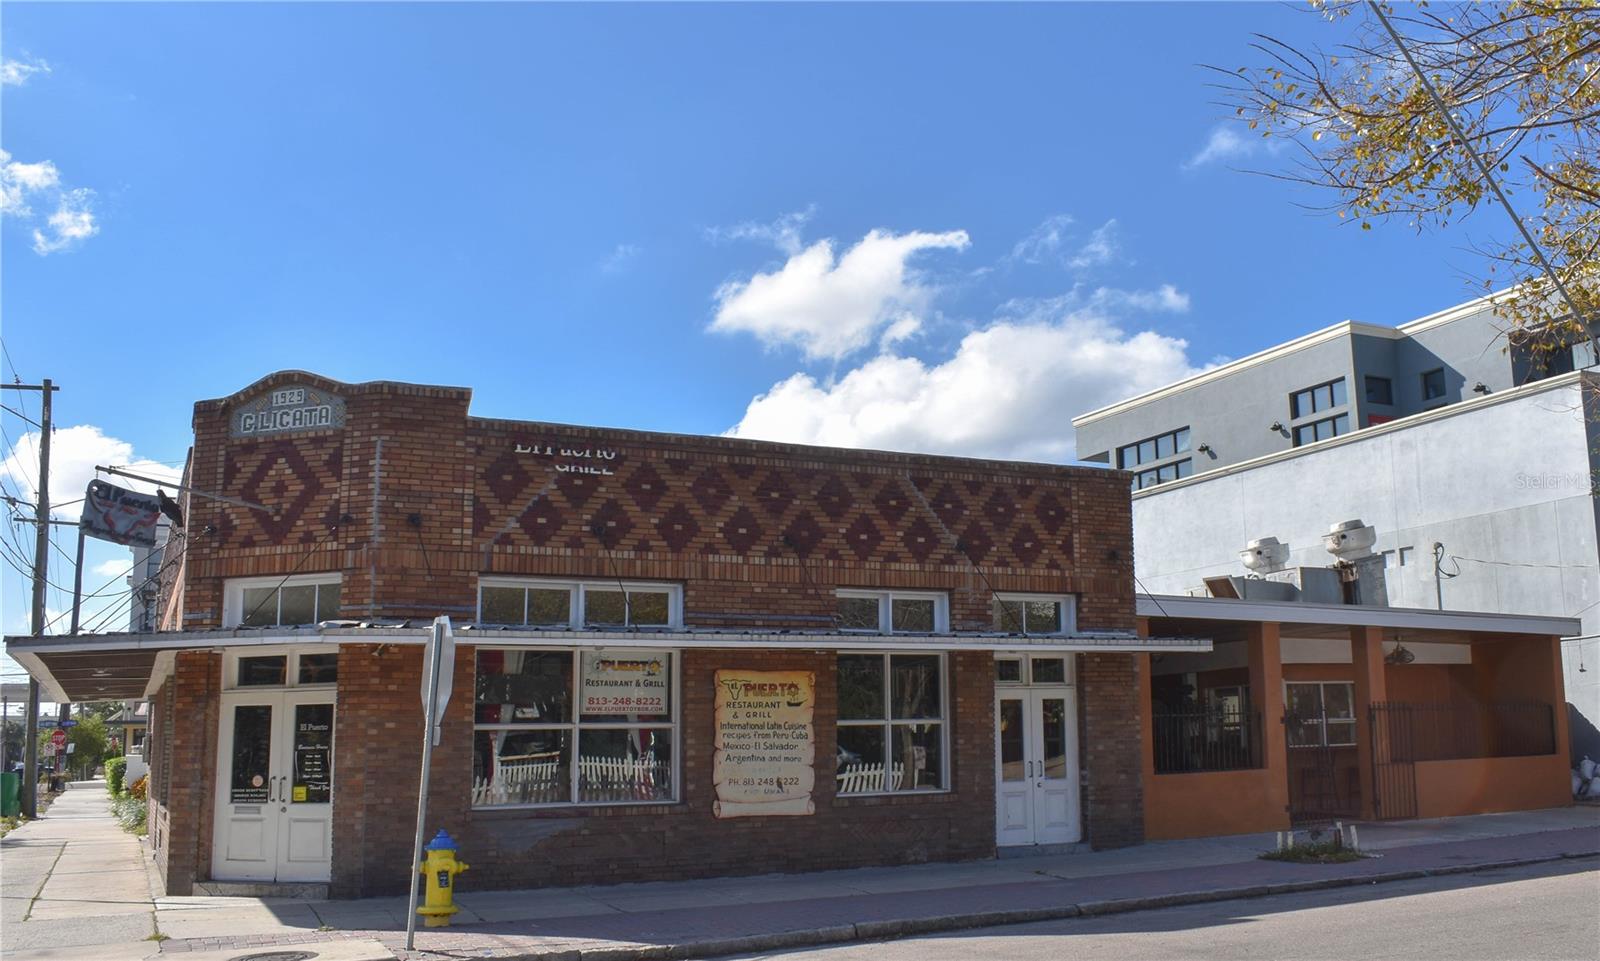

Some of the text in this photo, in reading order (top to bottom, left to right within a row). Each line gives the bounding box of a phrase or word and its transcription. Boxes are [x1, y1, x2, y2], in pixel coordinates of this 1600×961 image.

[274, 391, 304, 405] 1929
[259, 406, 331, 431] LICATA
[585, 678, 665, 688] RESTAURANT & GRILL
[743, 682, 800, 697] PUERTO
[588, 697, 661, 705] 813-248-8222
[726, 701, 781, 709] RESTAURANT
[720, 721, 807, 731] International Latin Cuisine
[722, 732, 751, 740] recipes
[754, 731, 771, 739] from
[763, 741, 799, 750] Salvador
[725, 754, 765, 764] Argentina
[742, 777, 755, 786] 813
[757, 777, 774, 786] 248
